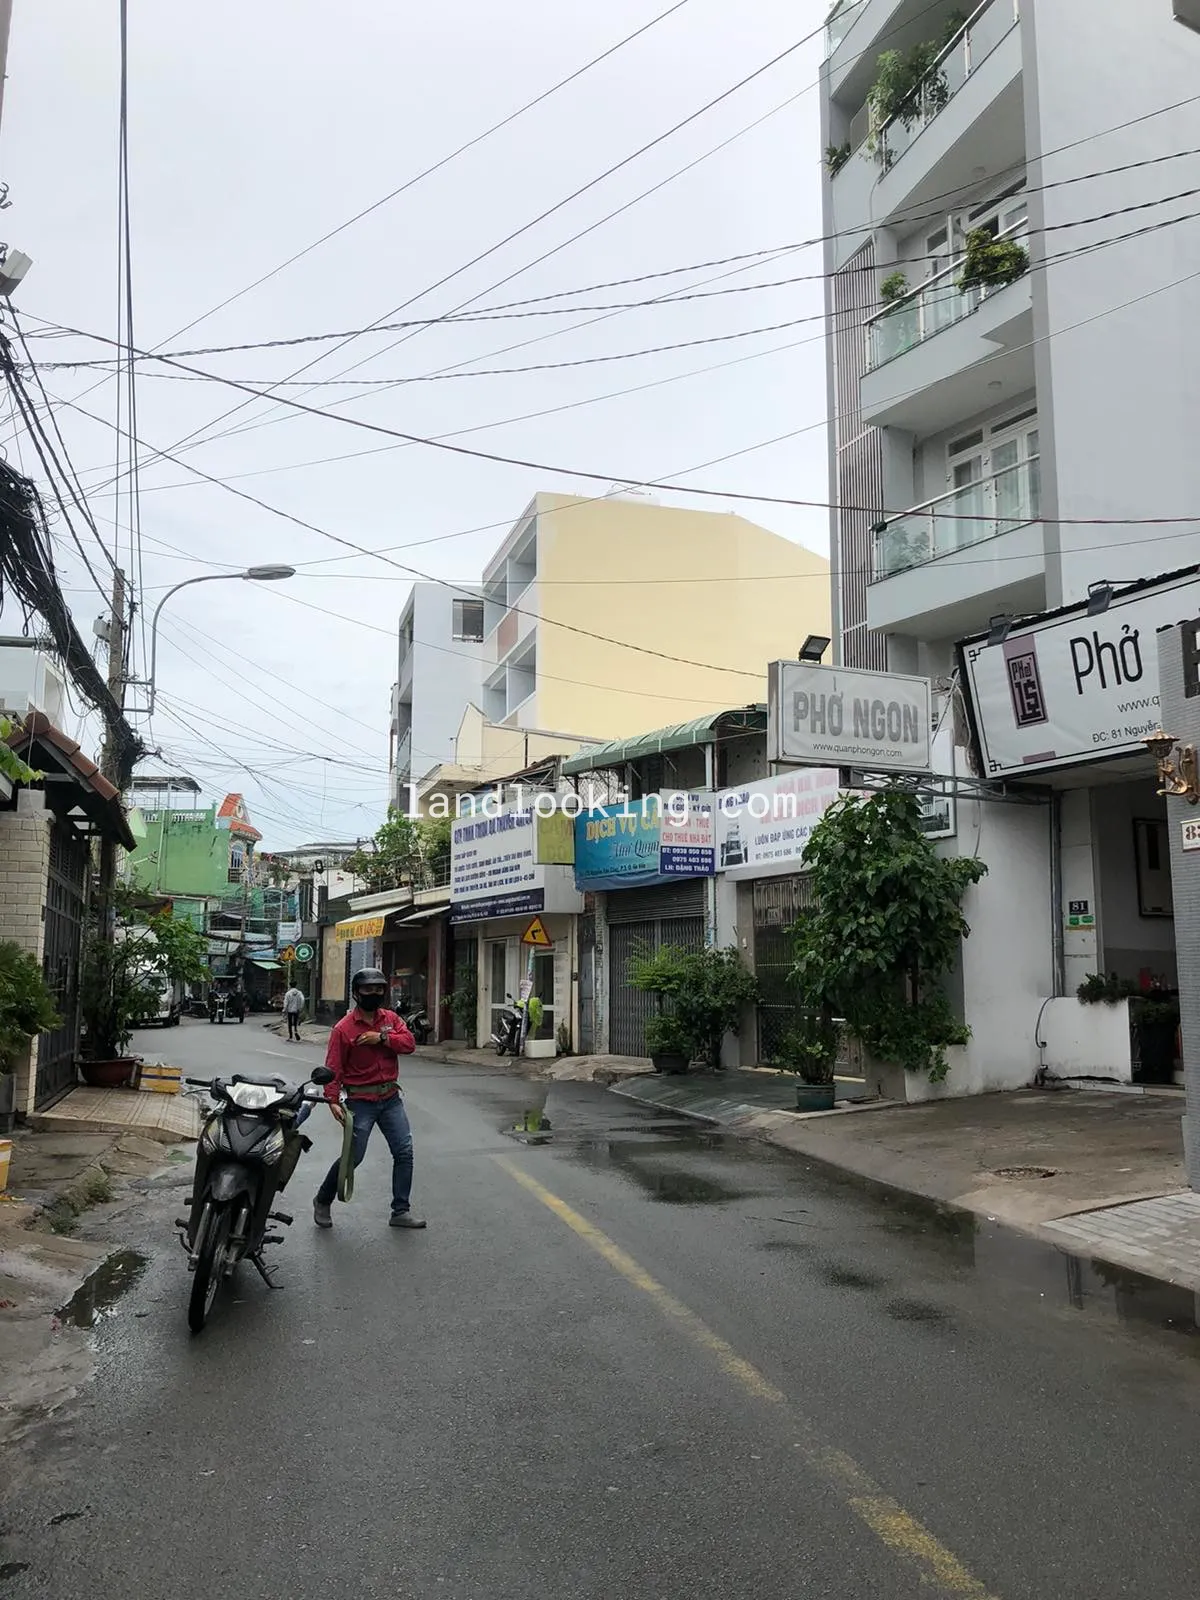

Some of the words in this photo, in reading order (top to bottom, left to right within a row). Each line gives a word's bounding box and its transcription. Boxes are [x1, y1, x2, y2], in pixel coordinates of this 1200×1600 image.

[1069, 624, 1144, 695] Phở
[853, 697, 920, 744] NGON
[1092, 731, 1110, 743] ĐC:
[1111, 728, 1122, 739] 81
[812, 742, 903, 758] www.quanphongon.com
[1072, 902, 1086, 911] 81
